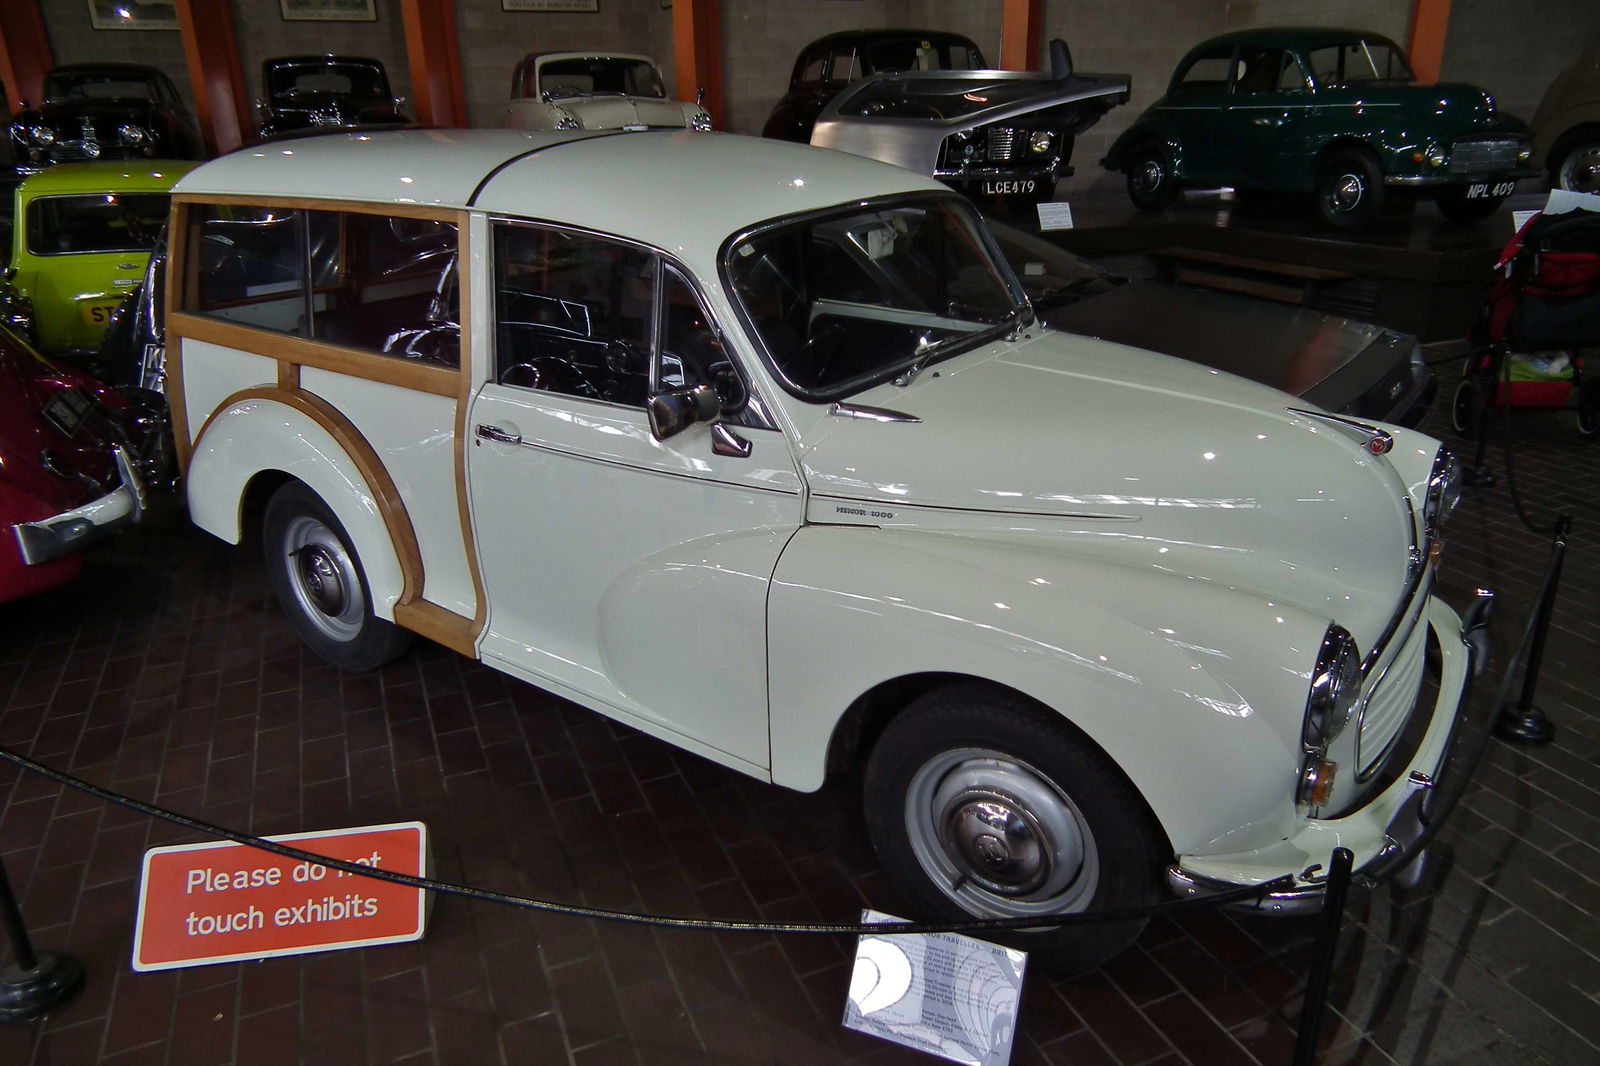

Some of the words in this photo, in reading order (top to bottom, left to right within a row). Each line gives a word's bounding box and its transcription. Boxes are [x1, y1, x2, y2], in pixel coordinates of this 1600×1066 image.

[986, 181, 1035, 195] LCE479
[1467, 184, 1489, 198] NPL
[1492, 181, 1515, 196] 409
[836, 506, 867, 516] MINOR
[871, 510, 893, 519] 1000
[187, 866, 282, 894] Please
[293, 860, 327, 883] do
[186, 905, 264, 936] touch
[274, 895, 378, 927] exhibits
